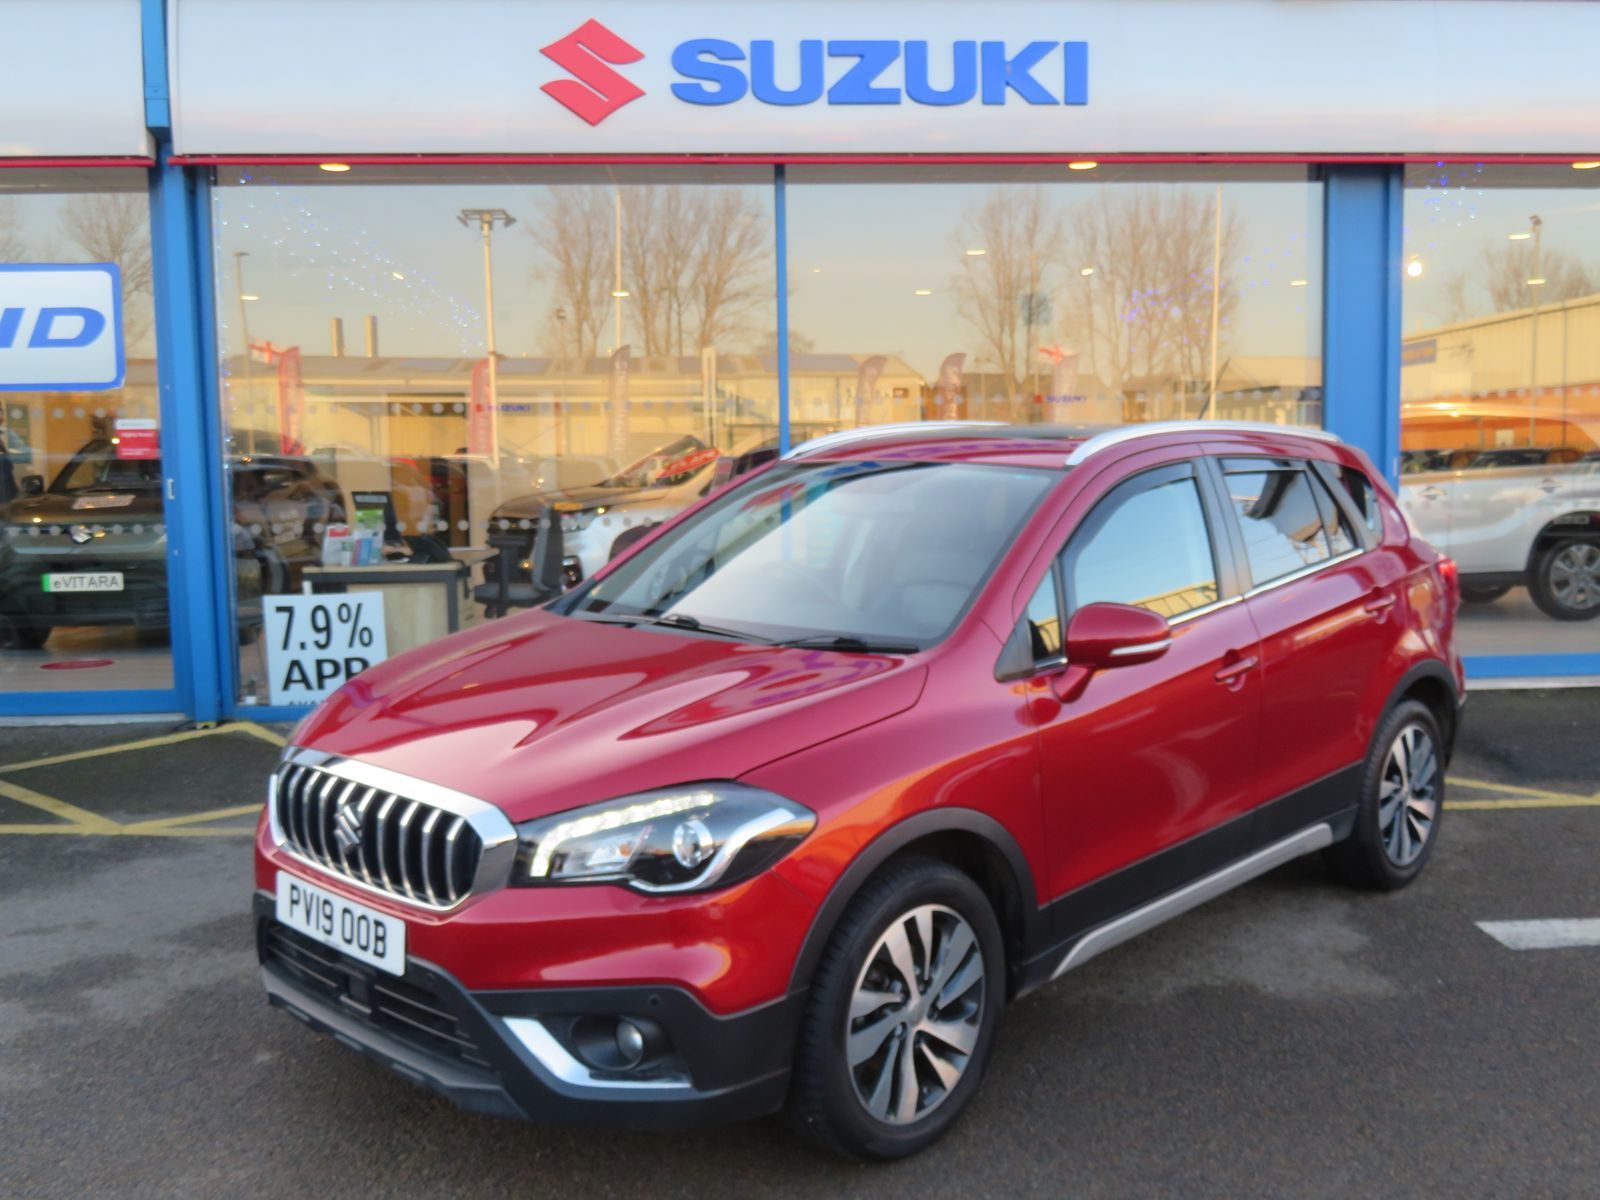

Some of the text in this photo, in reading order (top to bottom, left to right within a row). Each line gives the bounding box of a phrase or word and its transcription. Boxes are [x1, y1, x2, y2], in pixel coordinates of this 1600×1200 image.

[671, 38, 1088, 105] SUZUKI
[54, 576, 119, 589] eVITARA
[275, 603, 373, 650] 7.9%
[290, 883, 334, 936] PV19
